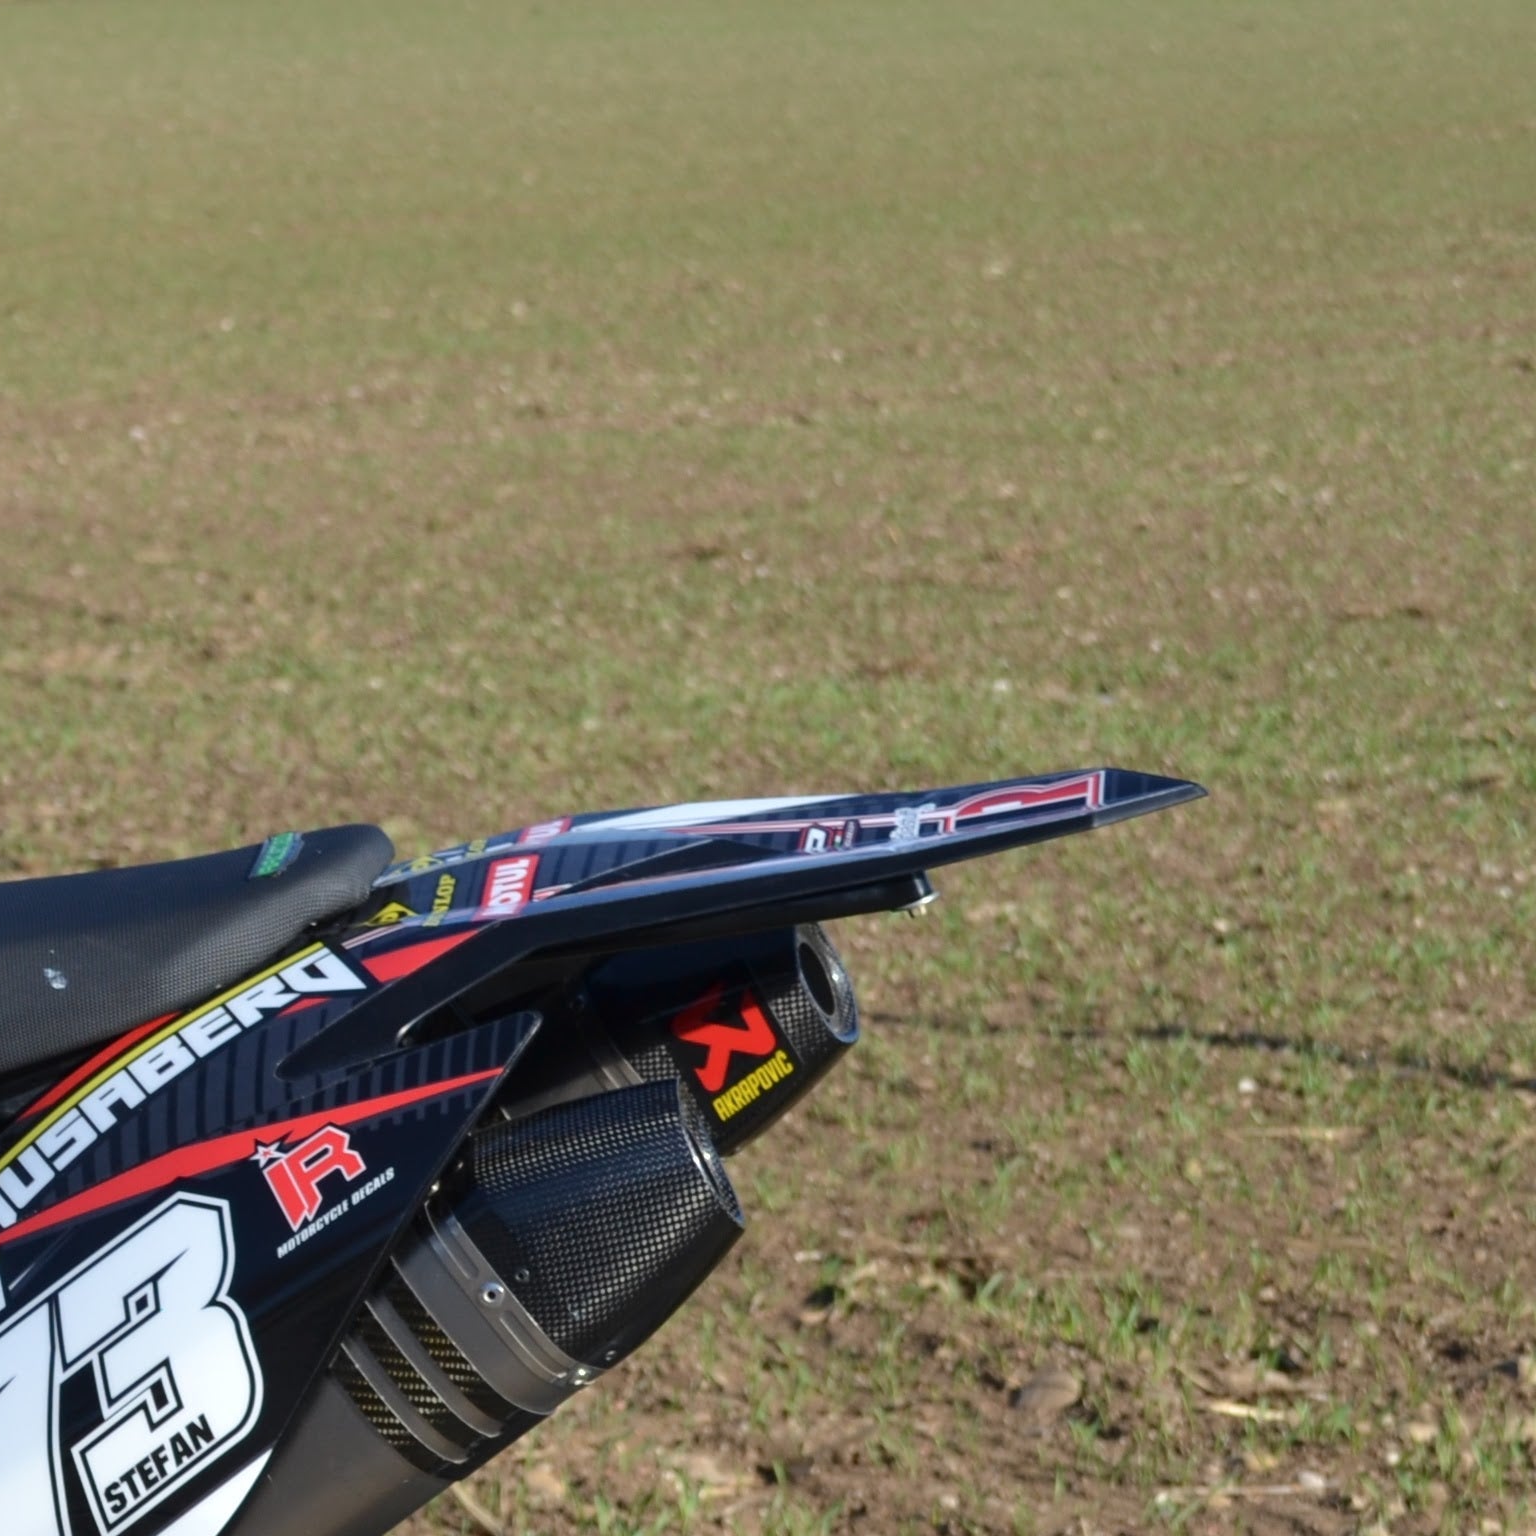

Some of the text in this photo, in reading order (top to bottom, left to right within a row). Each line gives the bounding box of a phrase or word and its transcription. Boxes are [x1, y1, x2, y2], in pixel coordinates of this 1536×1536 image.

[481, 858, 531, 915] MOTUL
[276, 1166, 395, 1259] MOTORCYCLE DECALS
[102, 1414, 215, 1515] STEFAN
